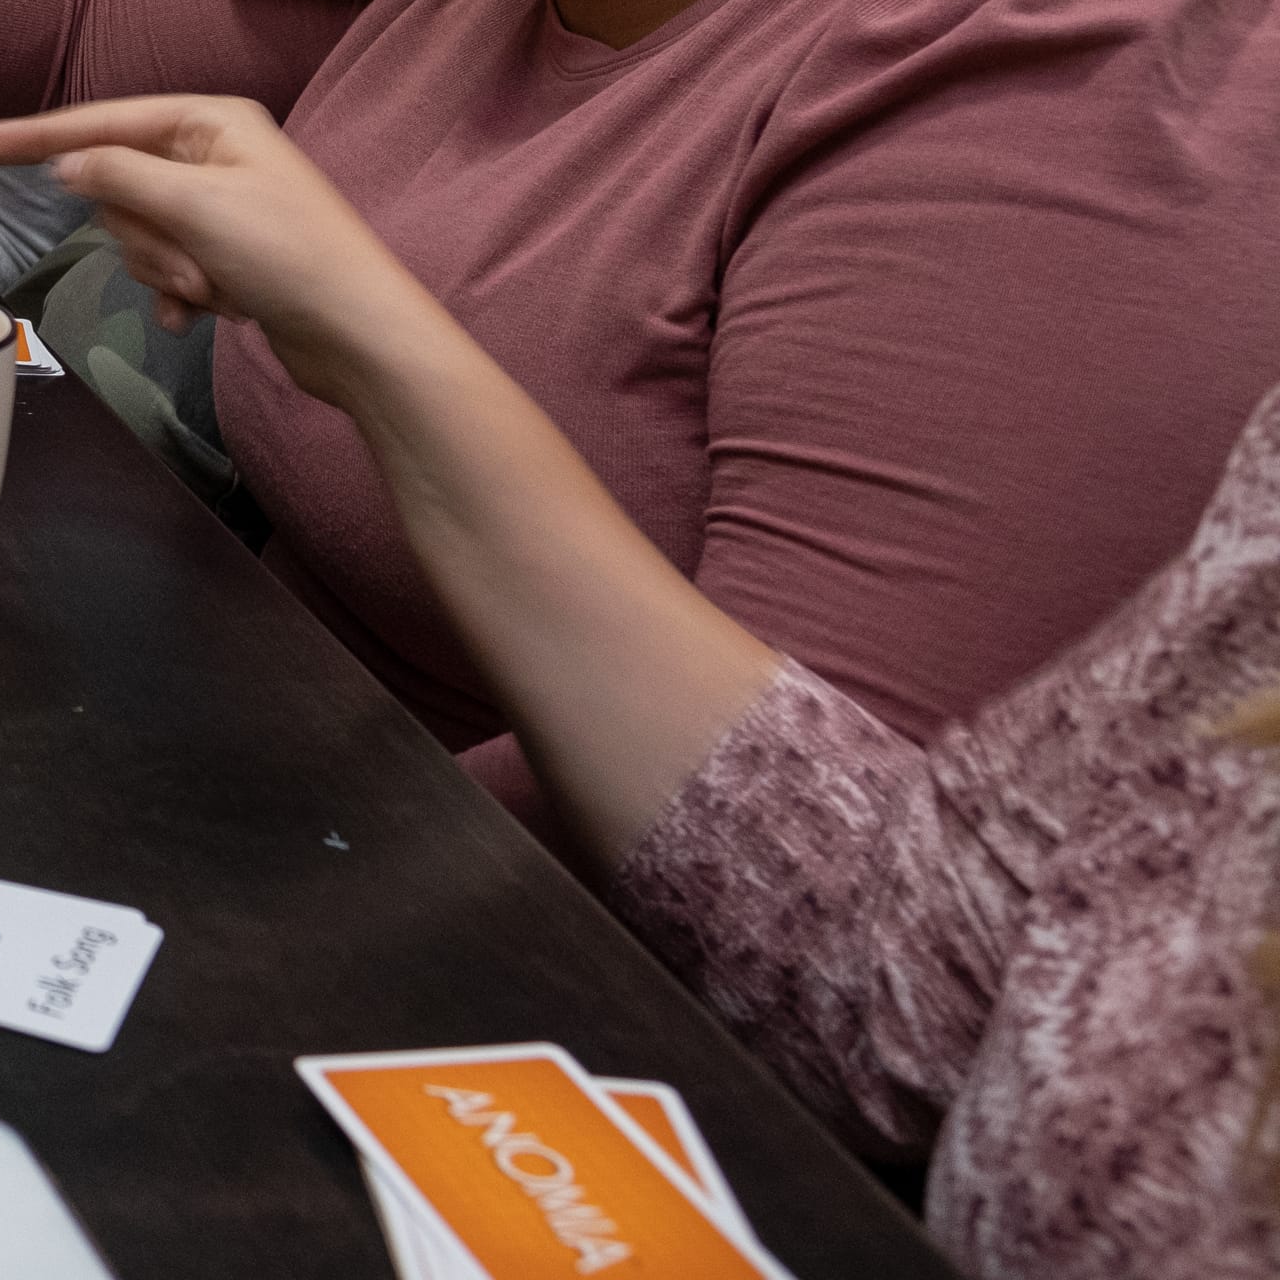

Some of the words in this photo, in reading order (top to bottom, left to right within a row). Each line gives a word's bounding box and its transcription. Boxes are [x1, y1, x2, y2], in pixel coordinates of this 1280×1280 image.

[49, 924, 119, 977] Song
[25, 973, 83, 1020] Folk
[424, 1083, 633, 1276] ANOMIA
